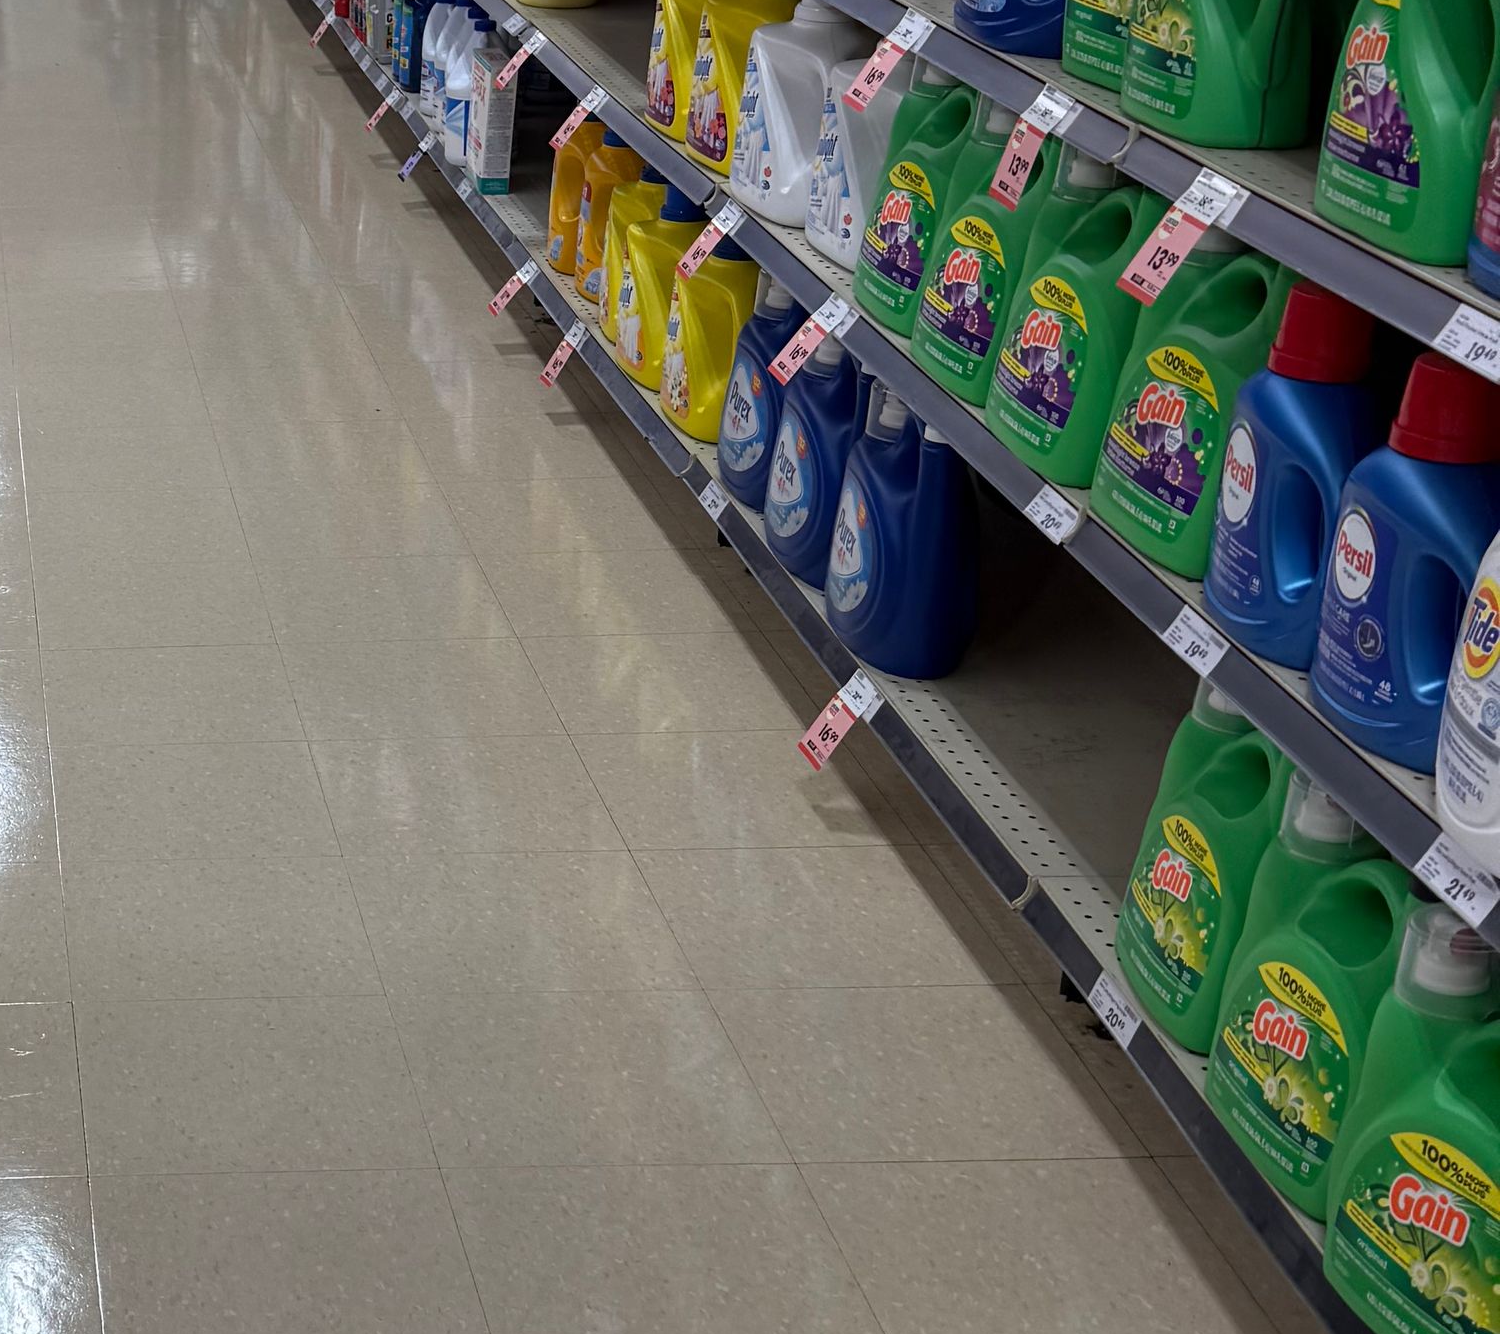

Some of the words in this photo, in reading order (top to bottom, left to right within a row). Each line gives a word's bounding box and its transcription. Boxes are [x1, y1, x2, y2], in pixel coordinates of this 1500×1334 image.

[1346, 24, 1390, 70] Gain
[880, 190, 912, 225] Gain
[944, 247, 982, 285] Gain
[1021, 309, 1063, 351] Gain
[1162, 349, 1188, 375] 100%
[729, 380, 752, 424] Purex
[1137, 381, 1187, 428] Gain
[775, 439, 797, 487] Purex
[1225, 444, 1254, 494] Persil
[835, 507, 857, 558] Purex
[1337, 529, 1374, 579] Persil
[1465, 597, 1500, 654] Tide
[1174, 819, 1195, 850] 100%
[1152, 848, 1193, 903] Gain
[1278, 967, 1308, 1006] 100%
[1307, 992, 1327, 1013] MORE
[1253, 998, 1309, 1061] Gain
[1421, 1139, 1465, 1186] 100%
[1465, 1171, 1491, 1194] MORE
[1389, 1173, 1470, 1247] Gain
[1462, 1179, 1487, 1201] PLUS
[1357, 1238, 1388, 1269] original
